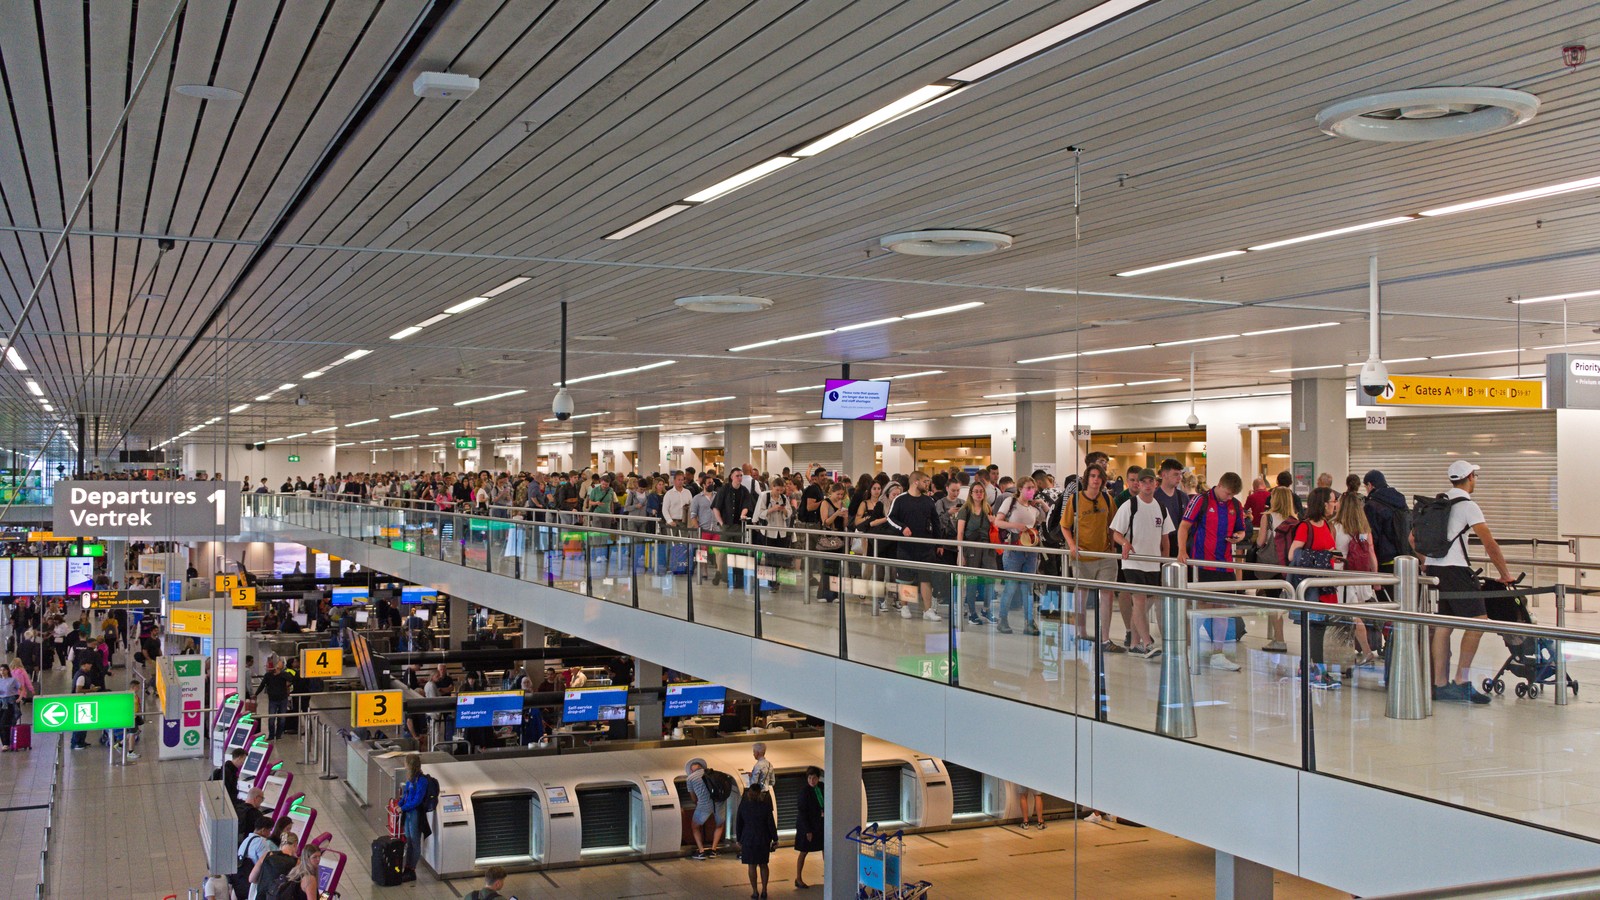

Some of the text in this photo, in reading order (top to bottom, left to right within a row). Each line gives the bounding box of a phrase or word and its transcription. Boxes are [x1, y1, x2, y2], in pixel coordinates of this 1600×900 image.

[1575, 362, 1600, 373] Priority
[1416, 385, 1442, 396] Gates
[1367, 416, 1385, 425] 20-21
[71, 488, 196, 509] Departures
[206, 489, 226, 525] 1
[70, 508, 152, 526] Vertrek
[240, 590, 246, 600] 5
[316, 652, 329, 668] 4
[373, 695, 387, 716] 3
